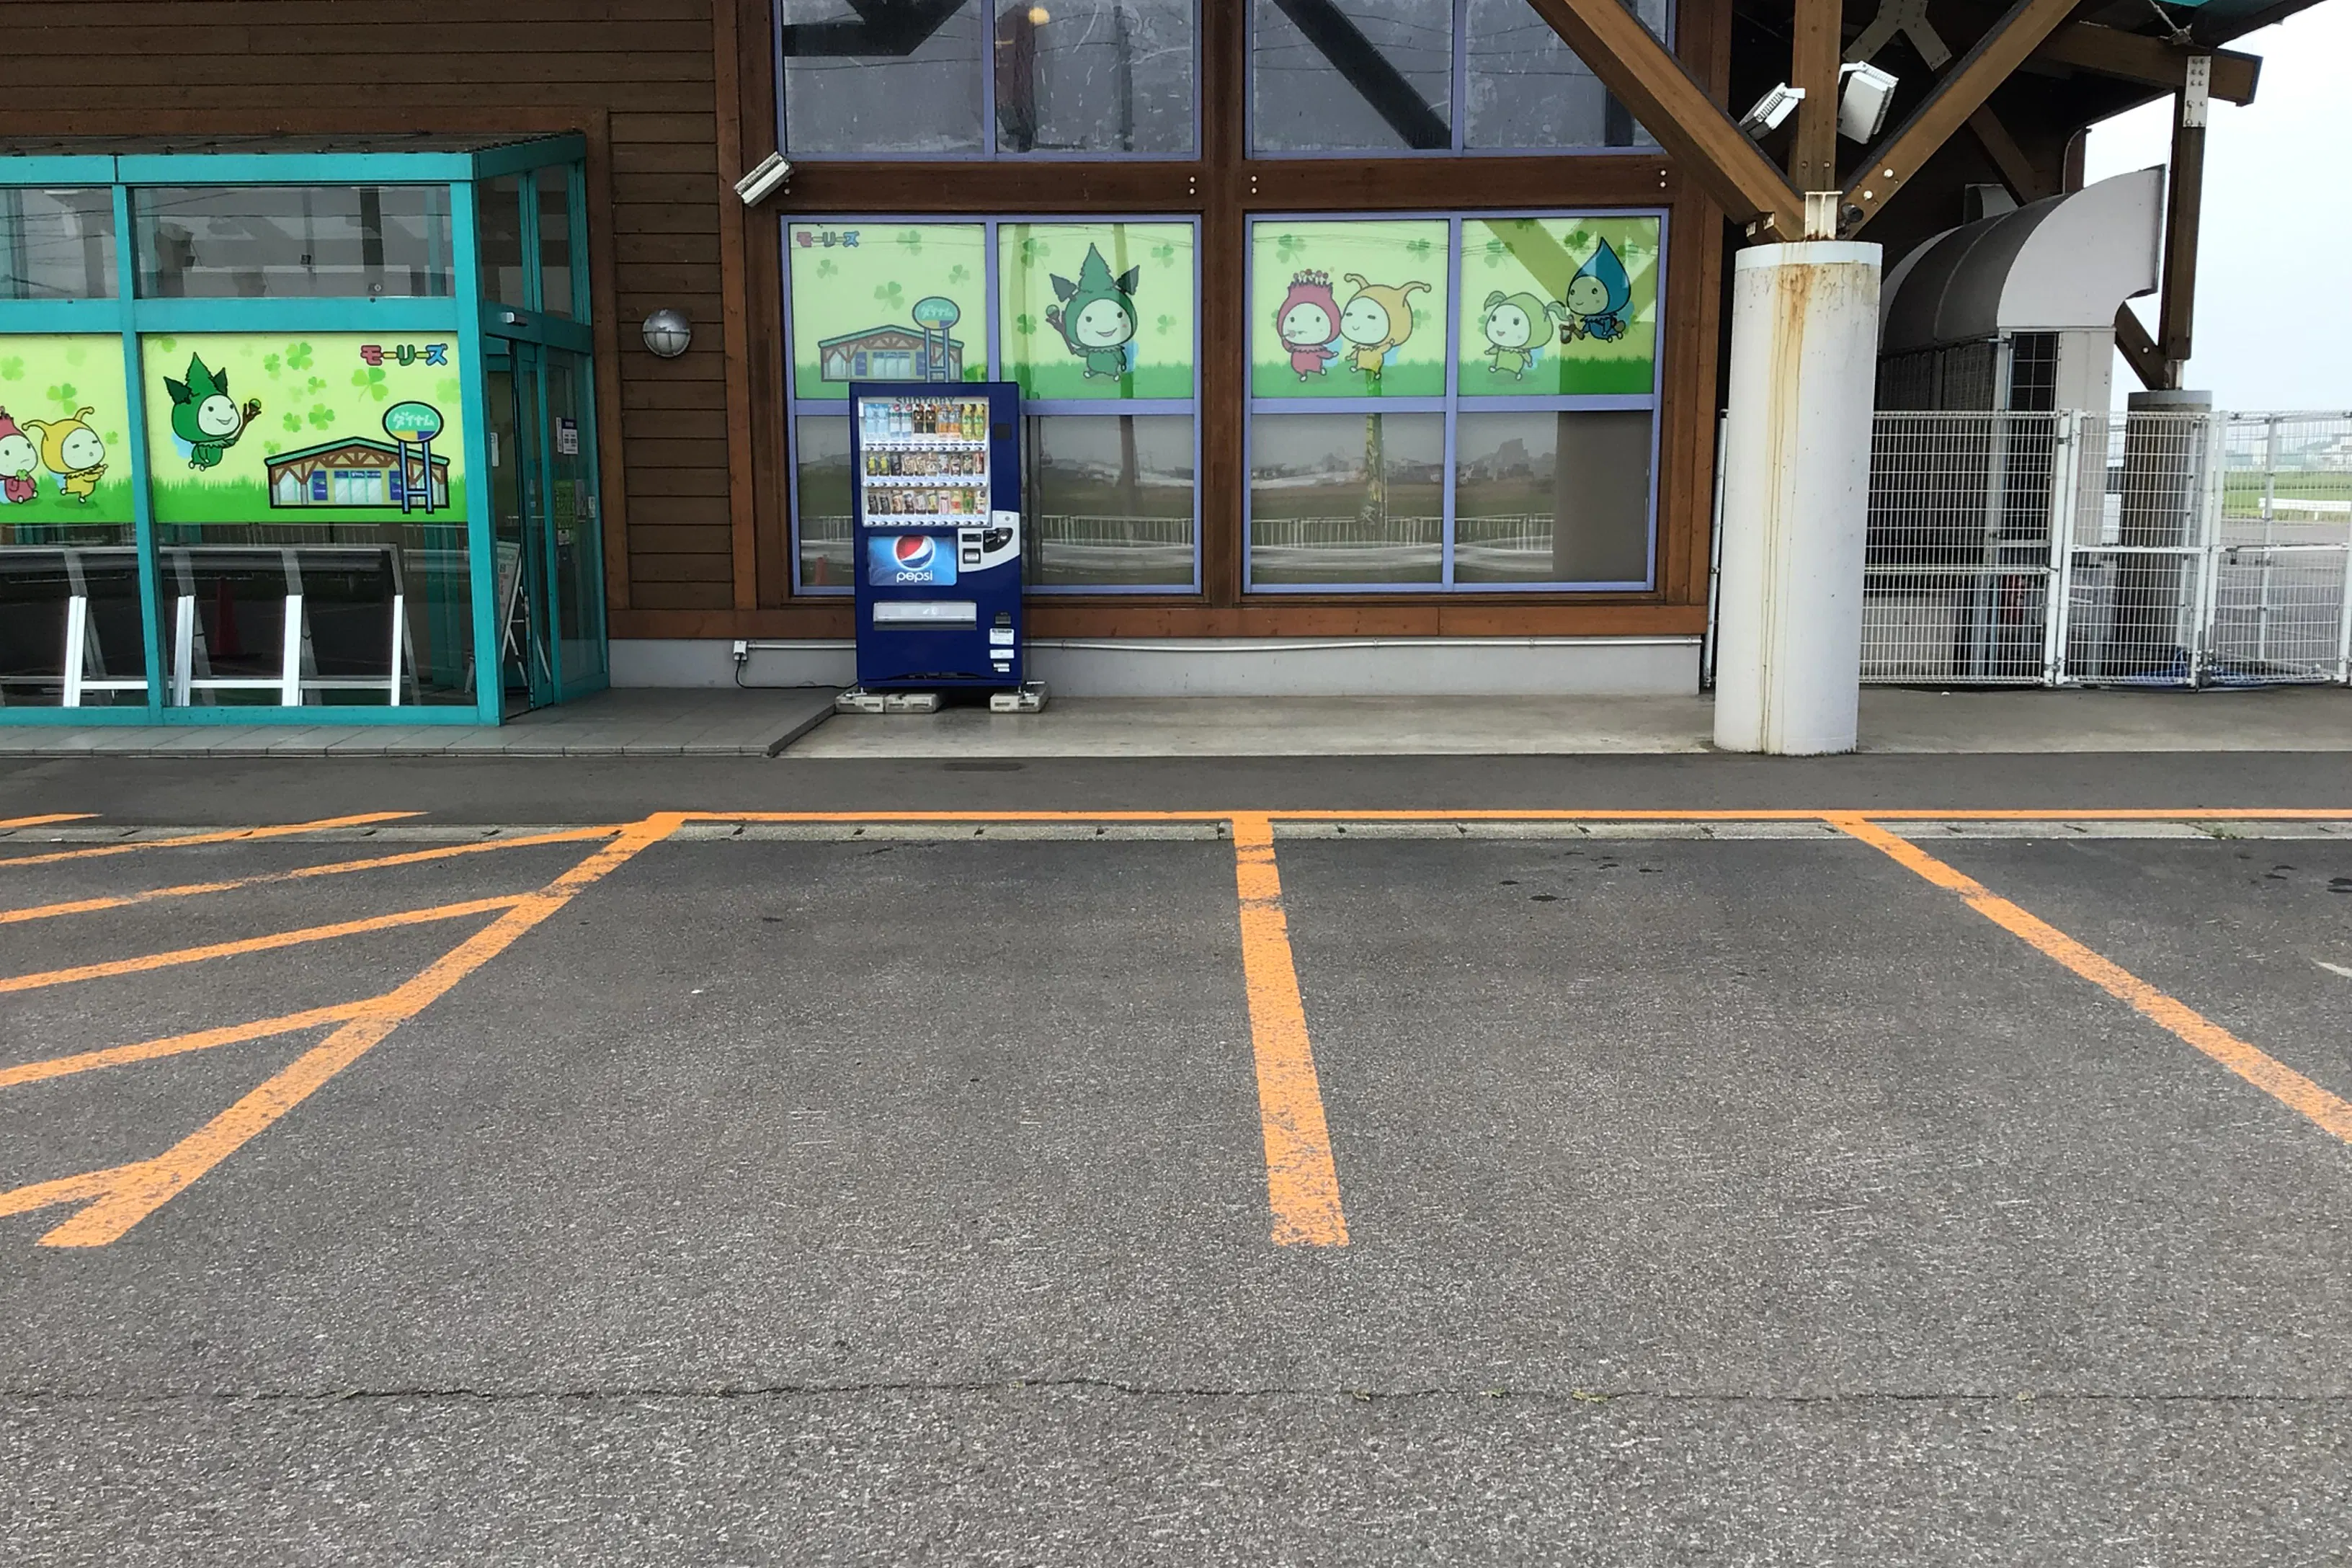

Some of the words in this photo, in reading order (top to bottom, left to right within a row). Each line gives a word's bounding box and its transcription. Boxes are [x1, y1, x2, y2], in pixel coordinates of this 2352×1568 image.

[796, 231, 860, 248] モーリーズ
[360, 343, 448, 366] モーリーズ
[896, 396, 956, 405] SUNTORY
[392, 411, 435, 429] ダイナム
[896, 570, 932, 583] pepsi
